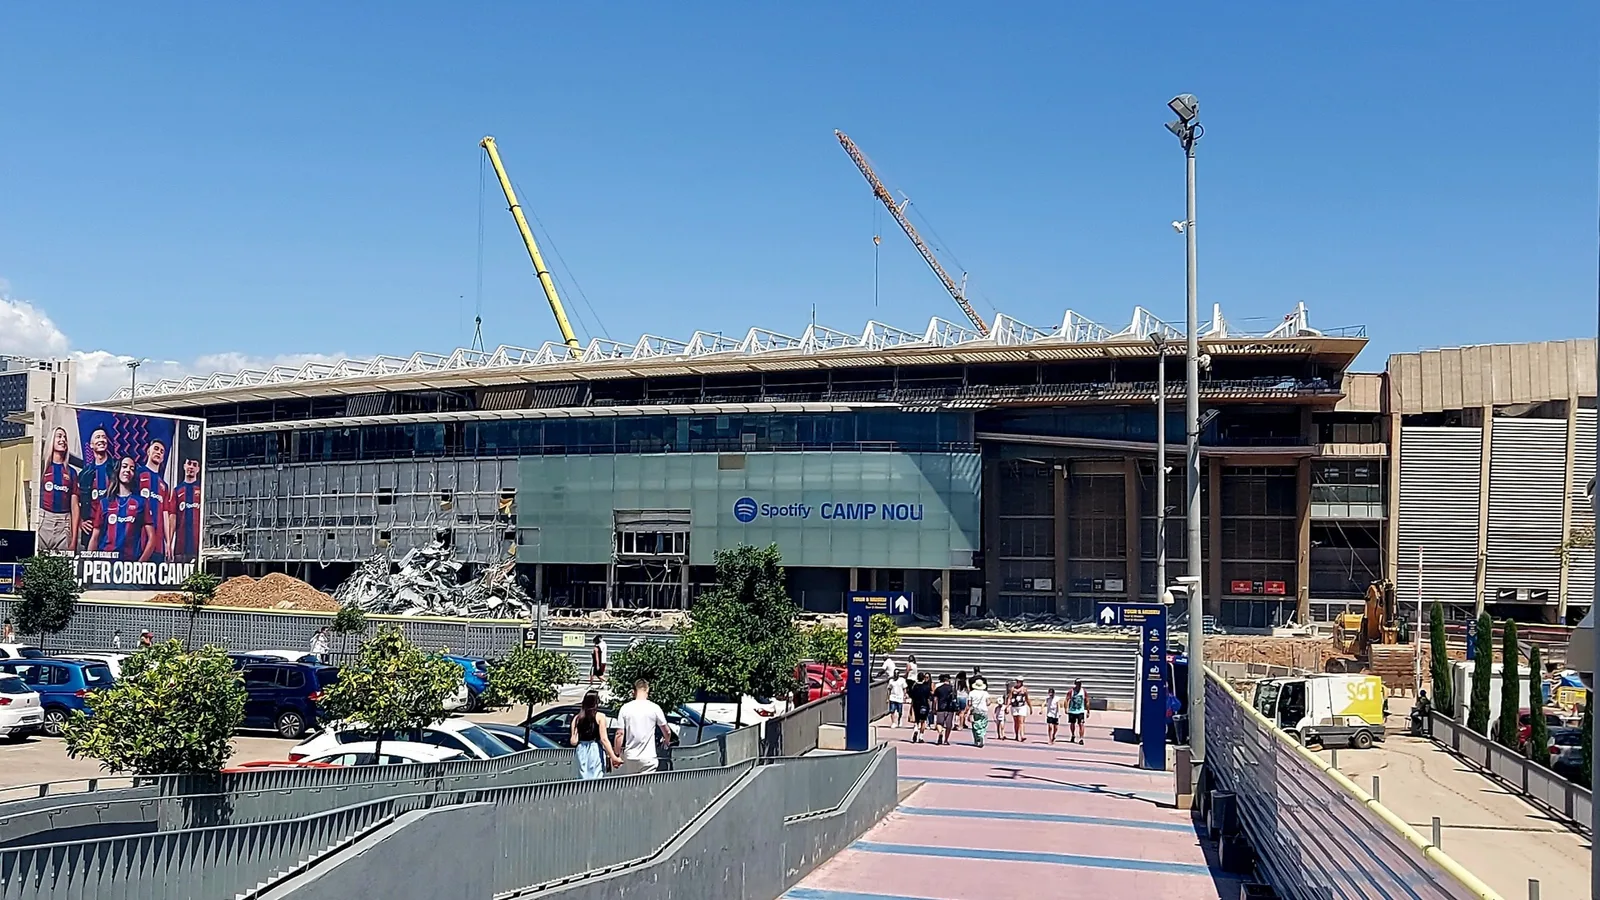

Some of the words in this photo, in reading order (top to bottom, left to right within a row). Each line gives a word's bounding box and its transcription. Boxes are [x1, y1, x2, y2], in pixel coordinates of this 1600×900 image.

[761, 504, 811, 518] Spotify
[820, 503, 877, 520] CAMP
[882, 504, 923, 520] NOU
[83, 560, 111, 583] PER
[112, 561, 157, 584] OBRIR
